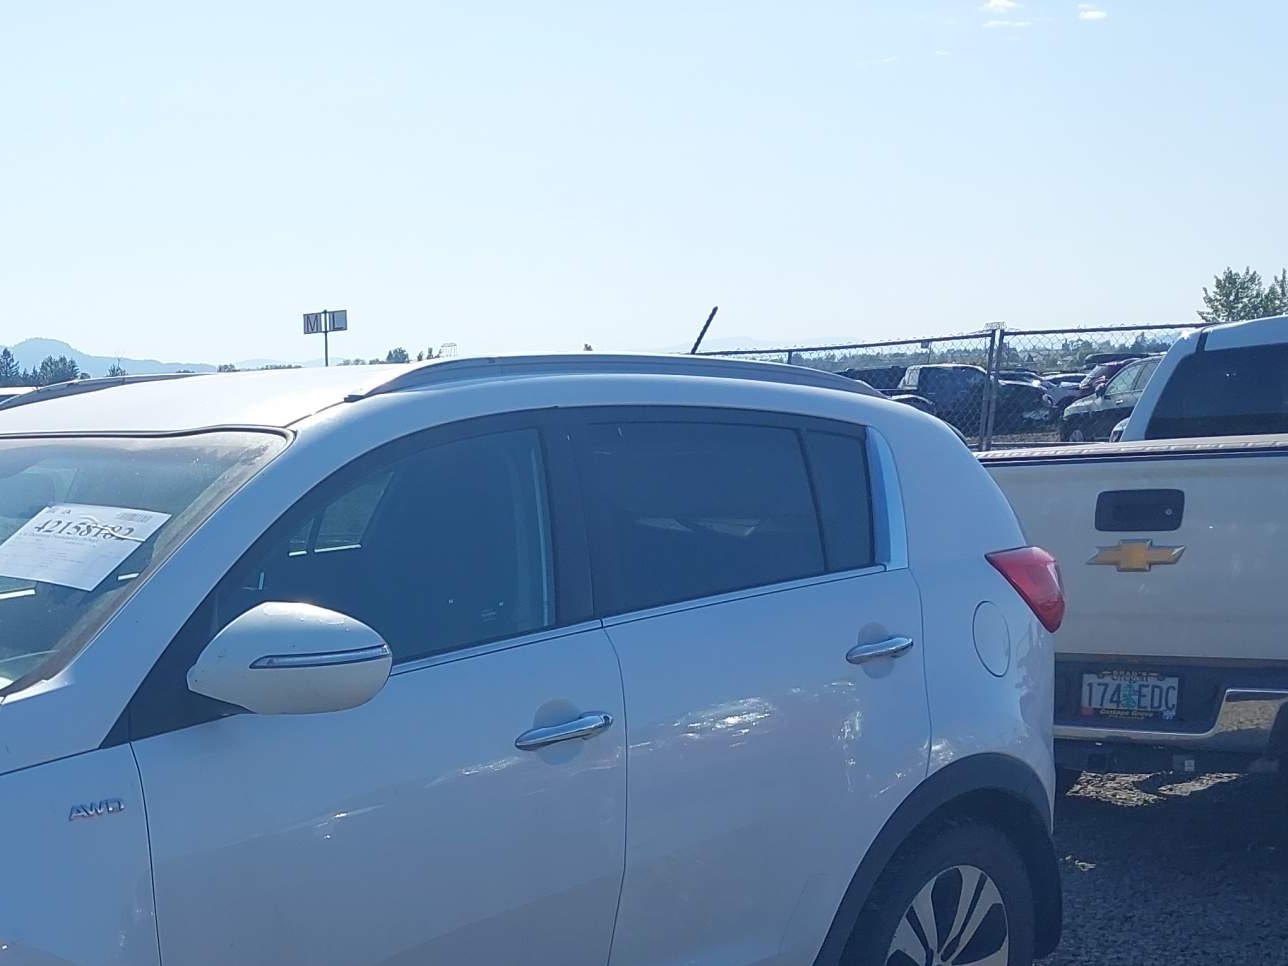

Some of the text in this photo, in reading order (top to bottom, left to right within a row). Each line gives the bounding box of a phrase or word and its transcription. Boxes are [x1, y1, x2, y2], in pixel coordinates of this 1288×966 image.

[1087, 683, 1177, 710] 174 EDC
[69, 800, 125, 821] AWD
